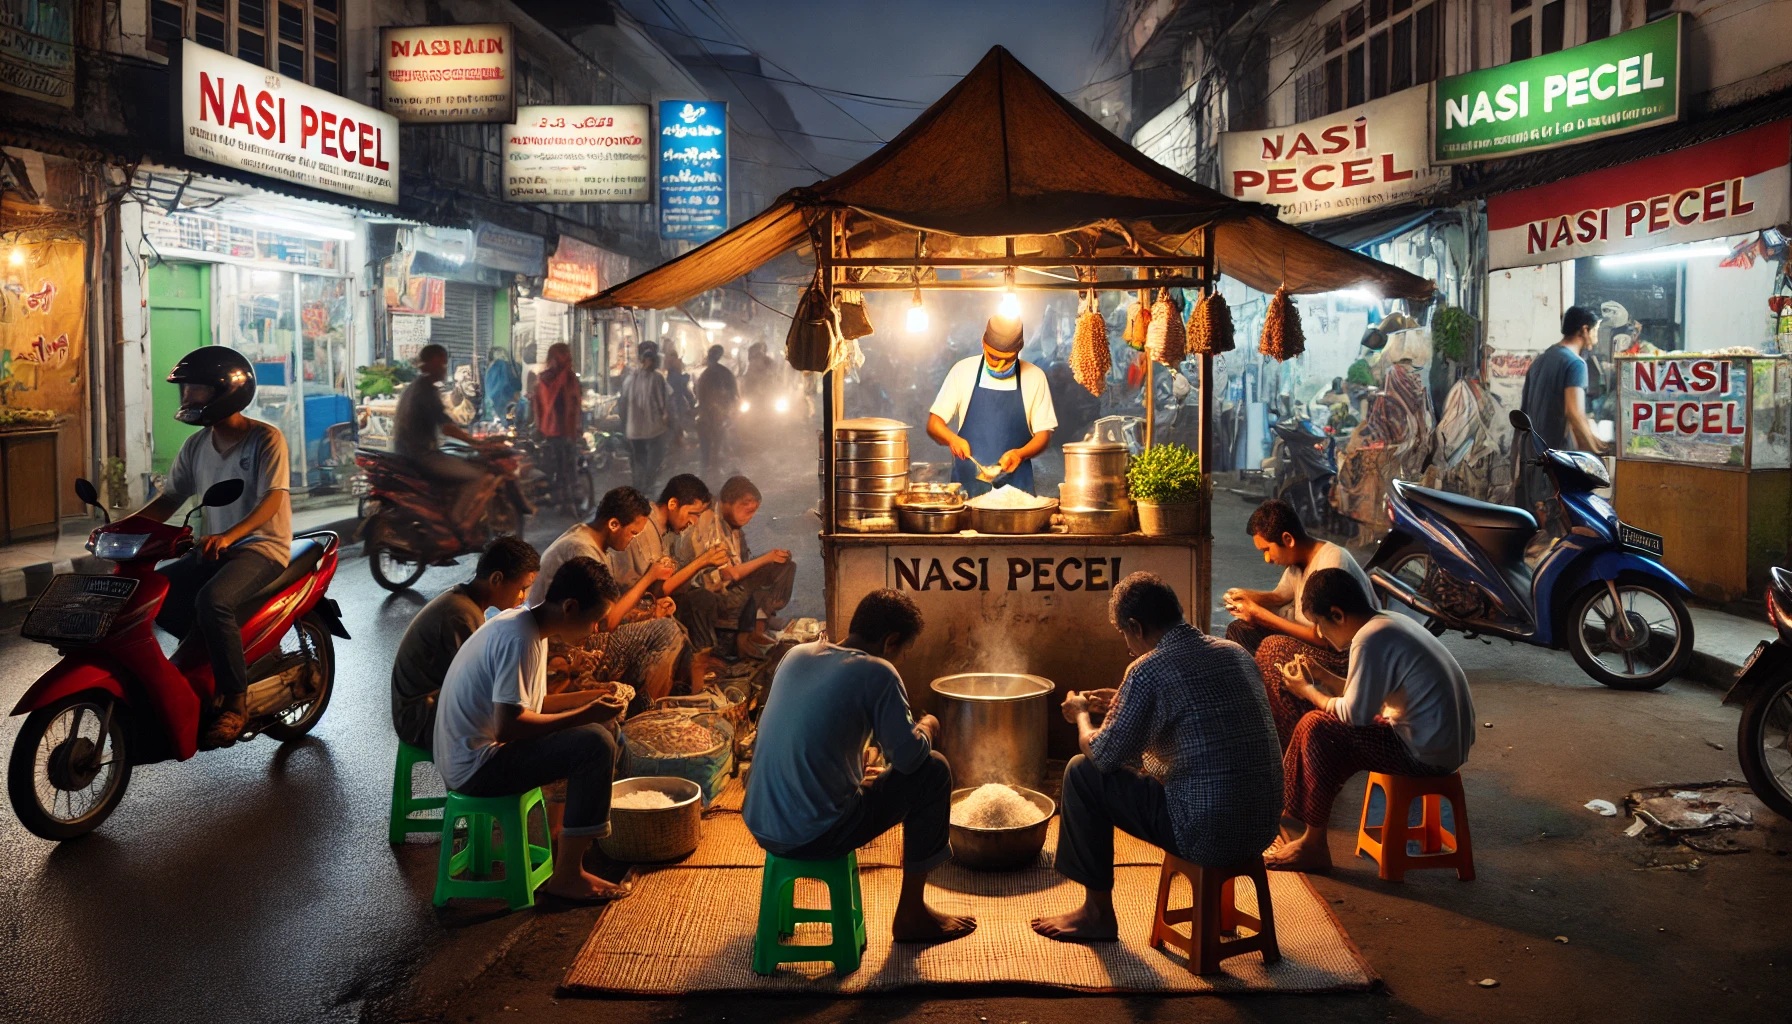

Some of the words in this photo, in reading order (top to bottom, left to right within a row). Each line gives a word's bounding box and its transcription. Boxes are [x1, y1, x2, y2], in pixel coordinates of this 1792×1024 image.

[1445, 80, 1529, 130] NASI
[1543, 52, 1665, 112] PECEL
[200, 71, 286, 144] NASI
[301, 104, 390, 171] PECEL
[1233, 153, 1413, 196] PECEL
[1527, 208, 1608, 255] NASI
[1624, 177, 1754, 237] PECEL
[1635, 361, 1730, 393] NASI
[1632, 403, 1745, 435] PECEL
[893, 556, 989, 591] NASI
